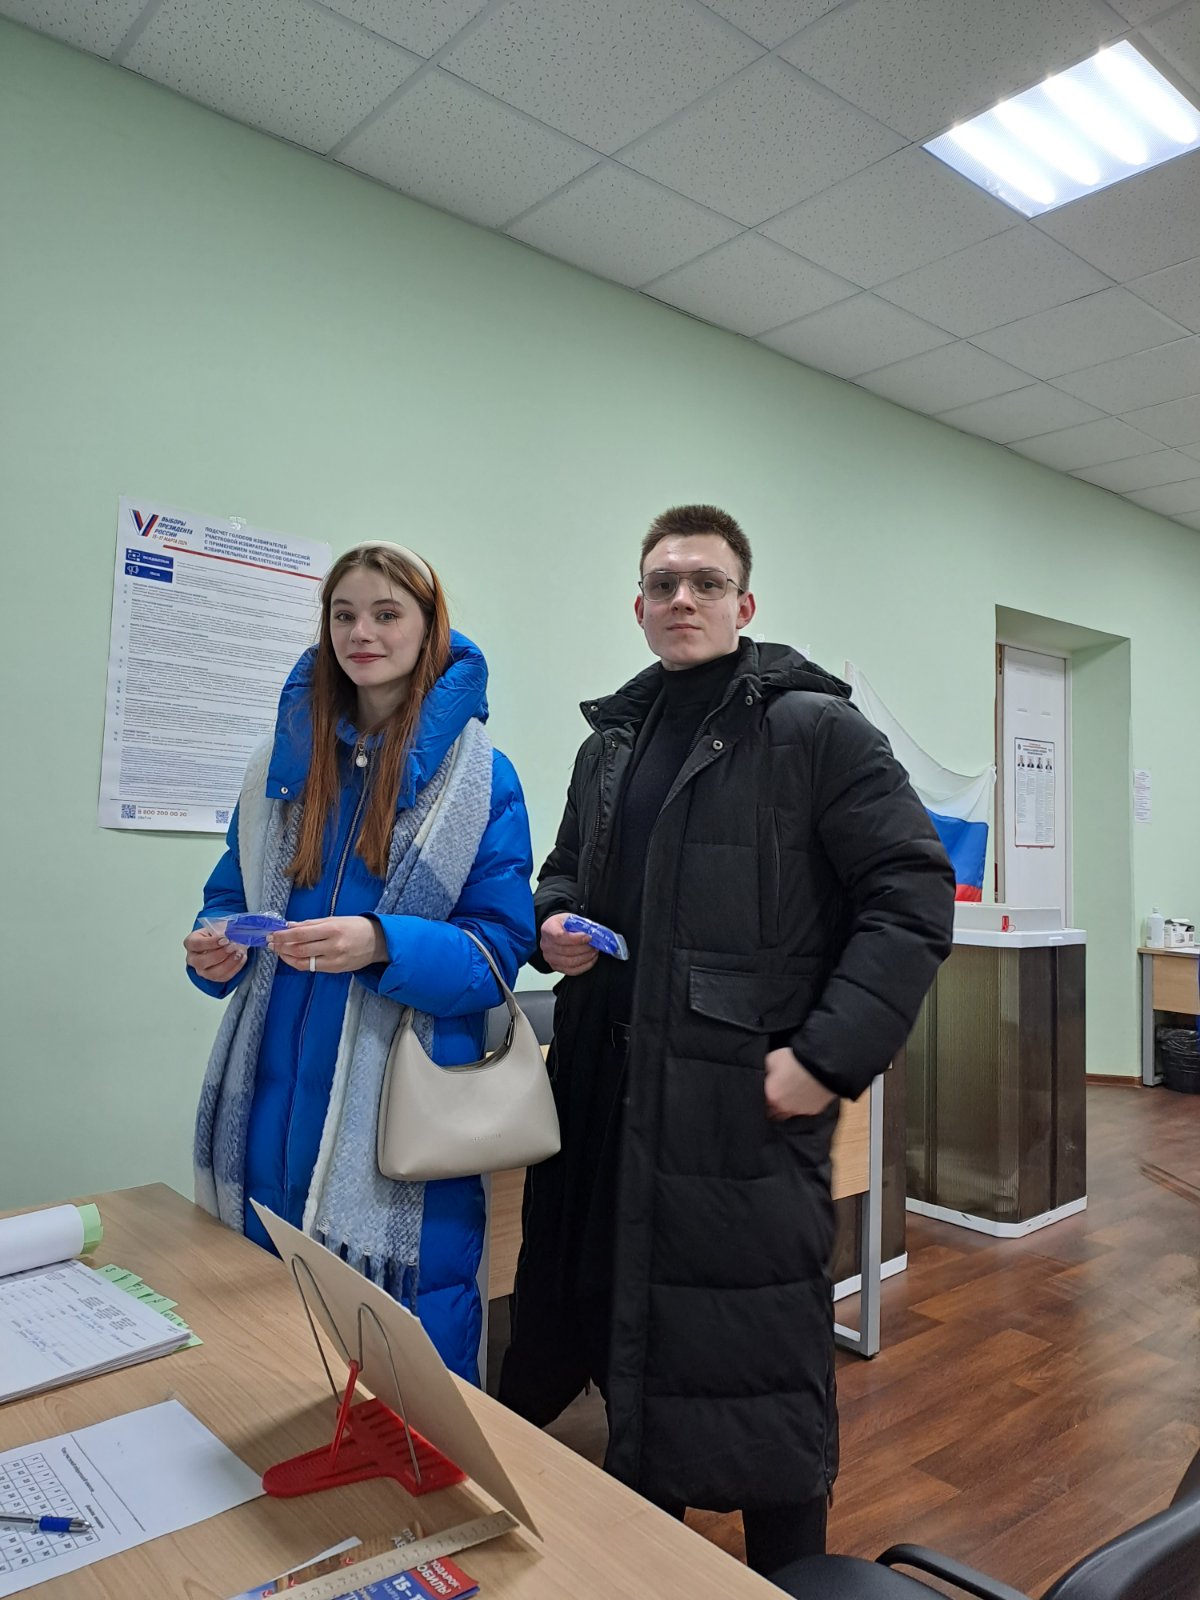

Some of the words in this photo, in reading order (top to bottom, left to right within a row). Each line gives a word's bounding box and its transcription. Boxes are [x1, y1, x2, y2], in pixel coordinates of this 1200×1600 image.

[158, 522, 193, 535] ПРЕЗИДЕНТА
[161, 517, 186, 526] ВЫБОРЫ
[154, 528, 178, 538] РОССИИ
[204, 526, 229, 537] ПОДСЧЕТ
[229, 532, 253, 542] ГОЛОСОВ
[253, 537, 288, 549] ИЗБИРАТЕЛЕЙ
[204, 533, 238, 545] УЧАСТКОВОЙ
[238, 541, 280, 554] ИЗБИРАТЕЛЬНОЙ
[281, 550, 311, 561] КОМИССИЕЙ
[204, 546, 248, 559] ИЗБИРАТЕЛЬНЫХ
[249, 555, 282, 567] БЮЛЛЕТЕНЕЙ
[208, 540, 248, 553] ПРИМЕНЕНИЕМ
[248, 549, 282, 561] КОМПЛЕКСОВ
